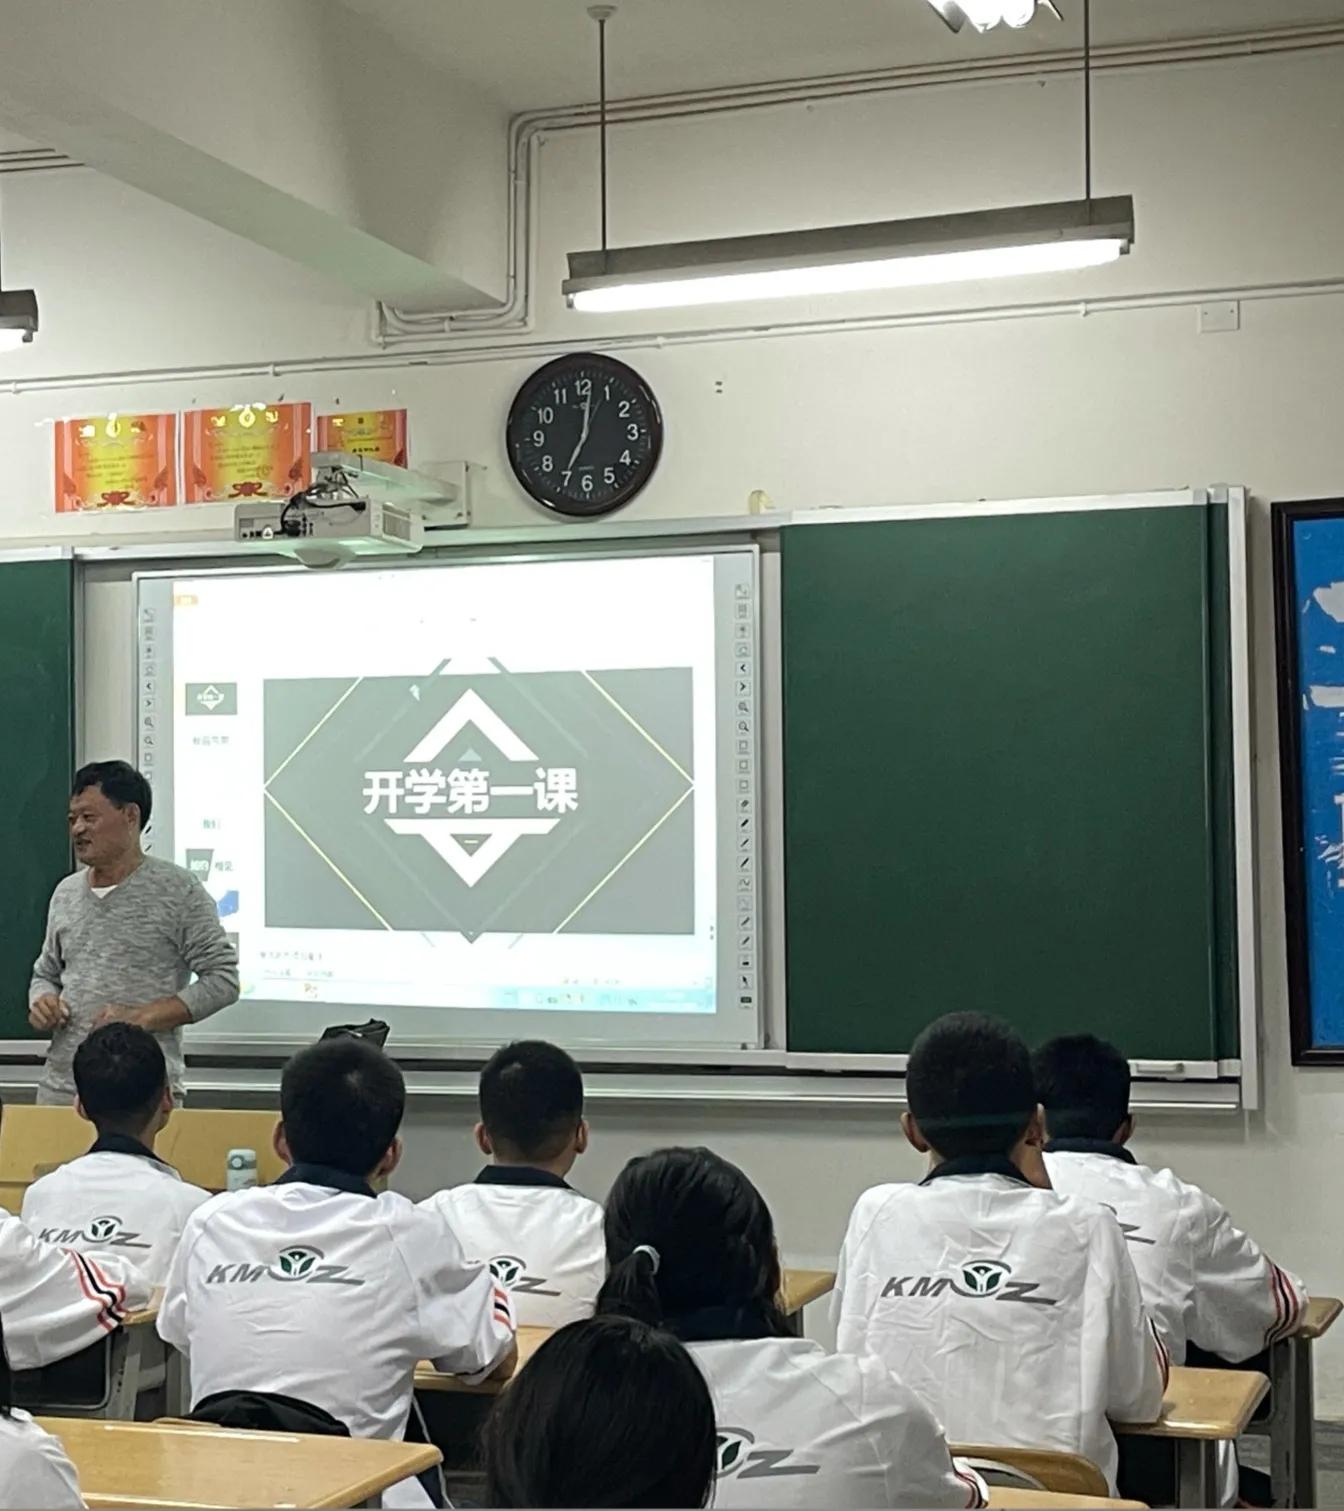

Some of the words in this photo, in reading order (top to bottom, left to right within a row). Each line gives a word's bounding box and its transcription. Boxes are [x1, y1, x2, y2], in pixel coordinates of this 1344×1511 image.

[575, 379, 592, 395] 12
[604, 384, 610, 401] 1
[554, 388, 567, 404] 11
[537, 407, 554, 424] 10
[618, 400, 630, 418] 2
[533, 430, 545, 447] 9
[627, 424, 639, 441] 3
[542, 455, 553, 472] 8
[619, 450, 631, 466] 4
[561, 471, 572, 487] 7
[581, 474, 593, 491] 6
[604, 467, 615, 484] 5
[362, 767, 579, 815] 开学第一课
